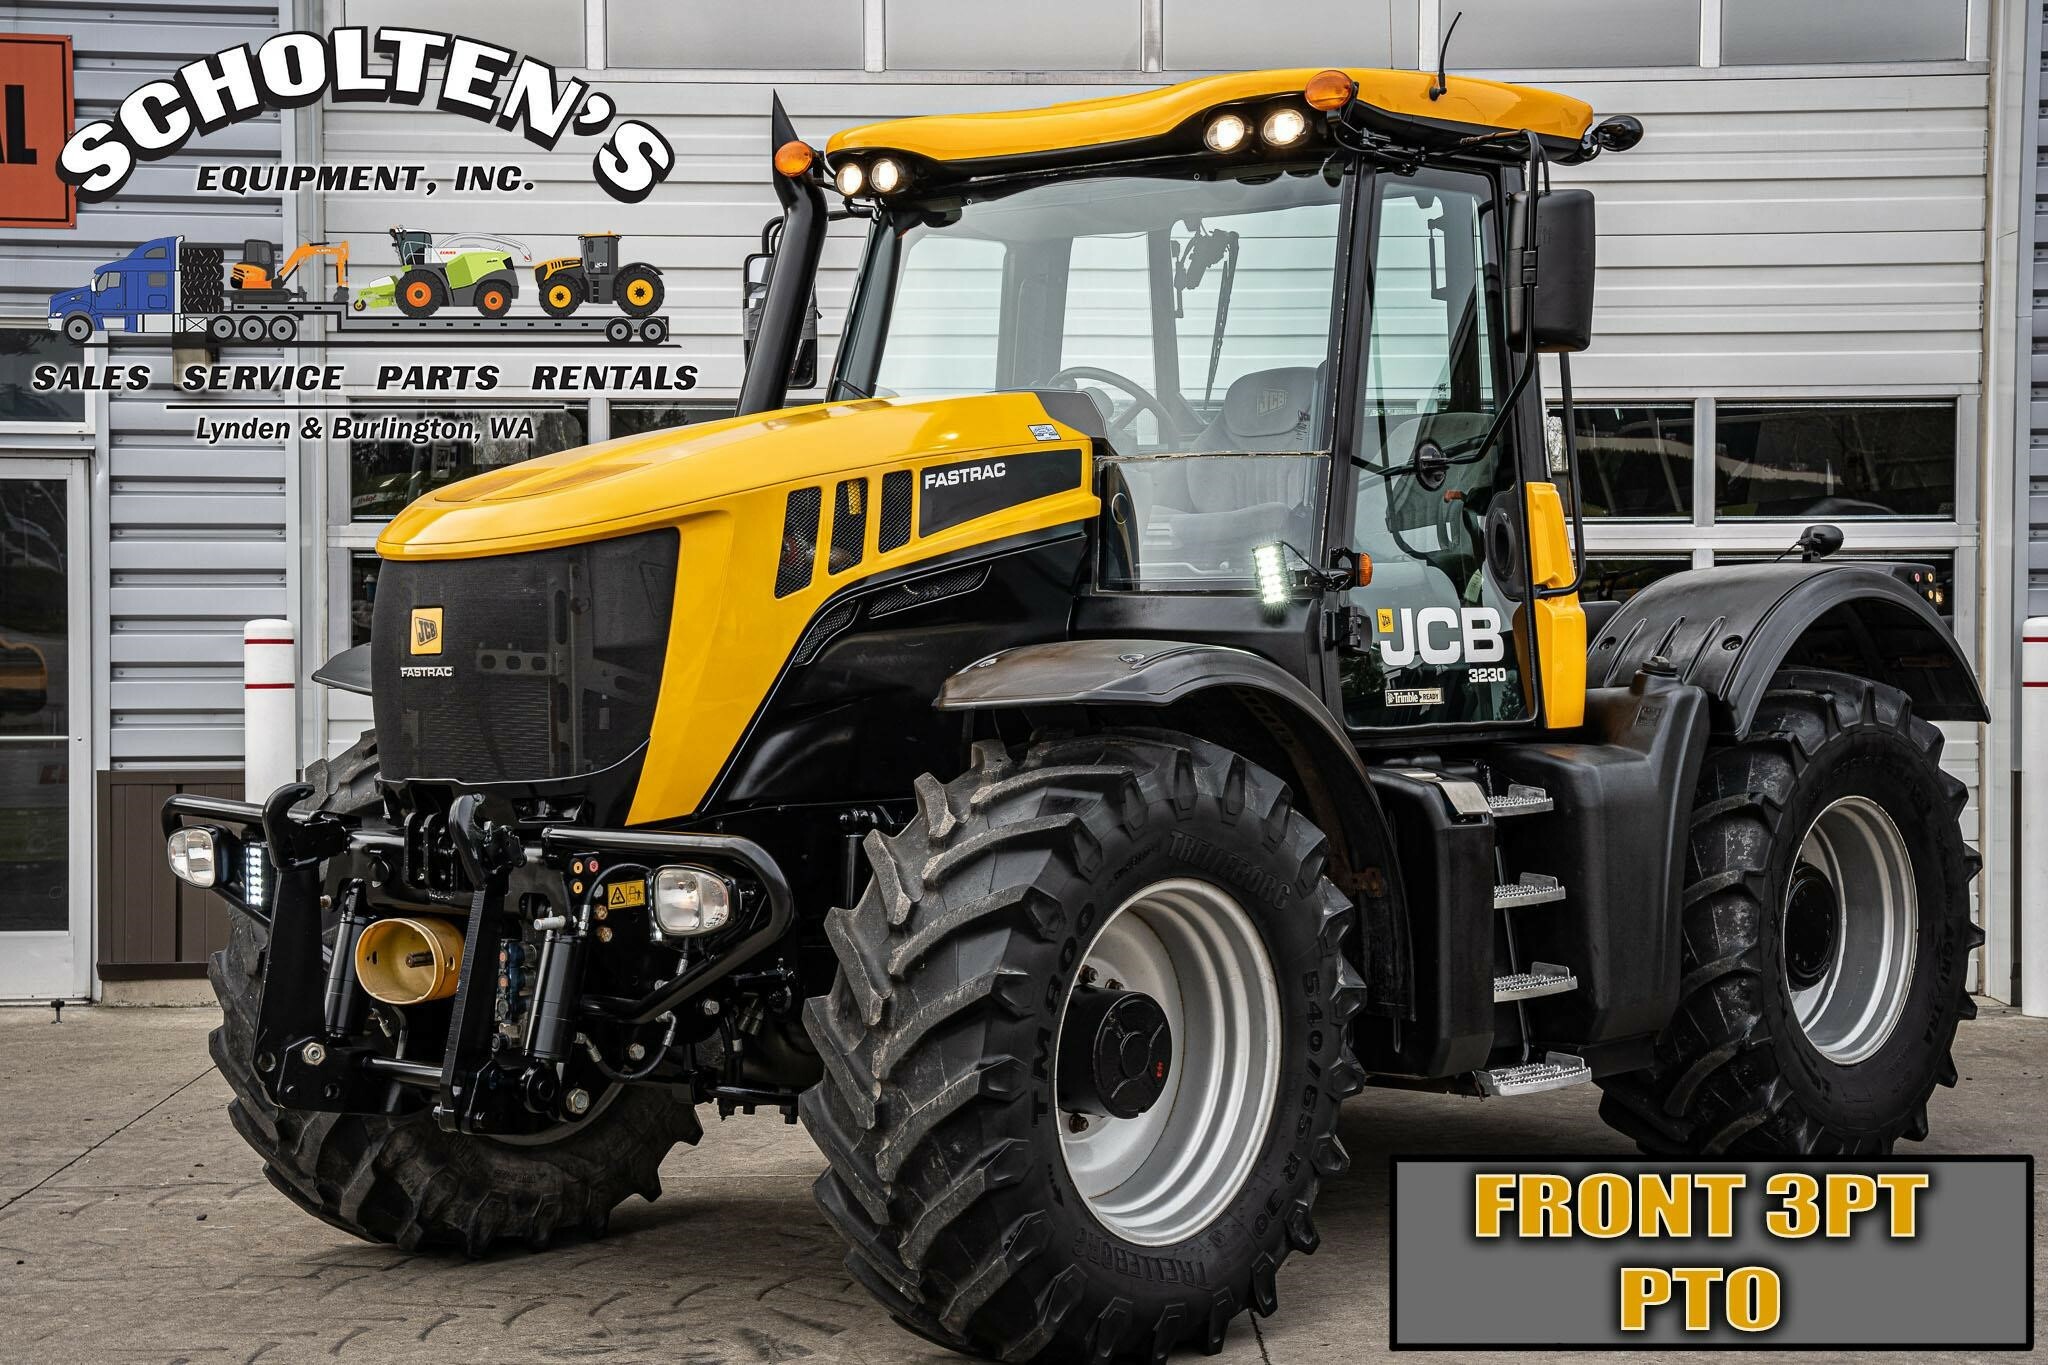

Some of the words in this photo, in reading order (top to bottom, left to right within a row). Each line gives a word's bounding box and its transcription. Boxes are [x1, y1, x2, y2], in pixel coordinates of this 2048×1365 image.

[0, 84, 38, 165] L
[924, 461, 1007, 490] FASTRAC
[417, 619, 437, 643] JCB
[1380, 606, 1505, 667] JCB
[400, 665, 453, 678] FASTRAC
[1468, 667, 1507, 683] 3230
[1393, 691, 1419, 704] Trimble
[1422, 693, 1440, 702] READY
